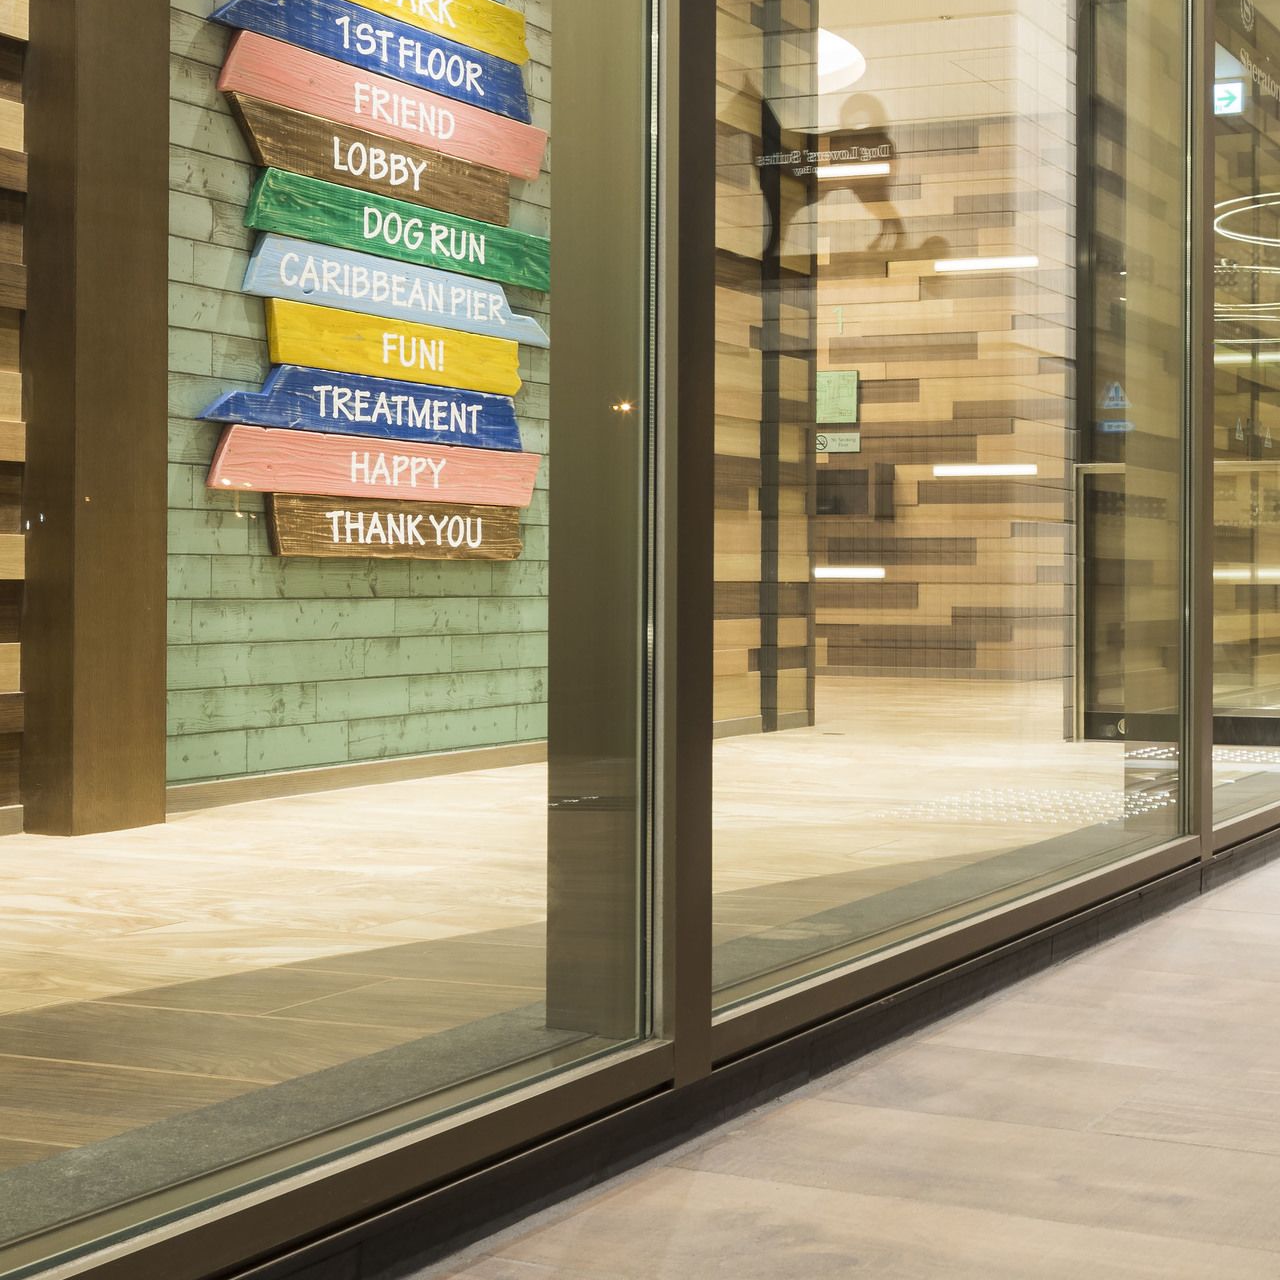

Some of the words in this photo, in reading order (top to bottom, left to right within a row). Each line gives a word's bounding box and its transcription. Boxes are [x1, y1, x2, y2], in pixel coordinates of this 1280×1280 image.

[335, 15, 390, 61] 1ST
[399, 38, 485, 96] FLOOR
[353, 82, 456, 140] FRIEND
[333, 136, 428, 192] LOBBY
[363, 206, 423, 251] DOG
[430, 221, 486, 265] RUN
[279, 251, 444, 315] CARIBBEAN
[451, 291, 506, 325] PIER
[382, 332, 444, 371] FUN!
[313, 385, 482, 434] TREATMENT
[351, 452, 447, 489] HAPPY
[326, 510, 430, 546] THANK
[430, 515, 482, 548] YOU
